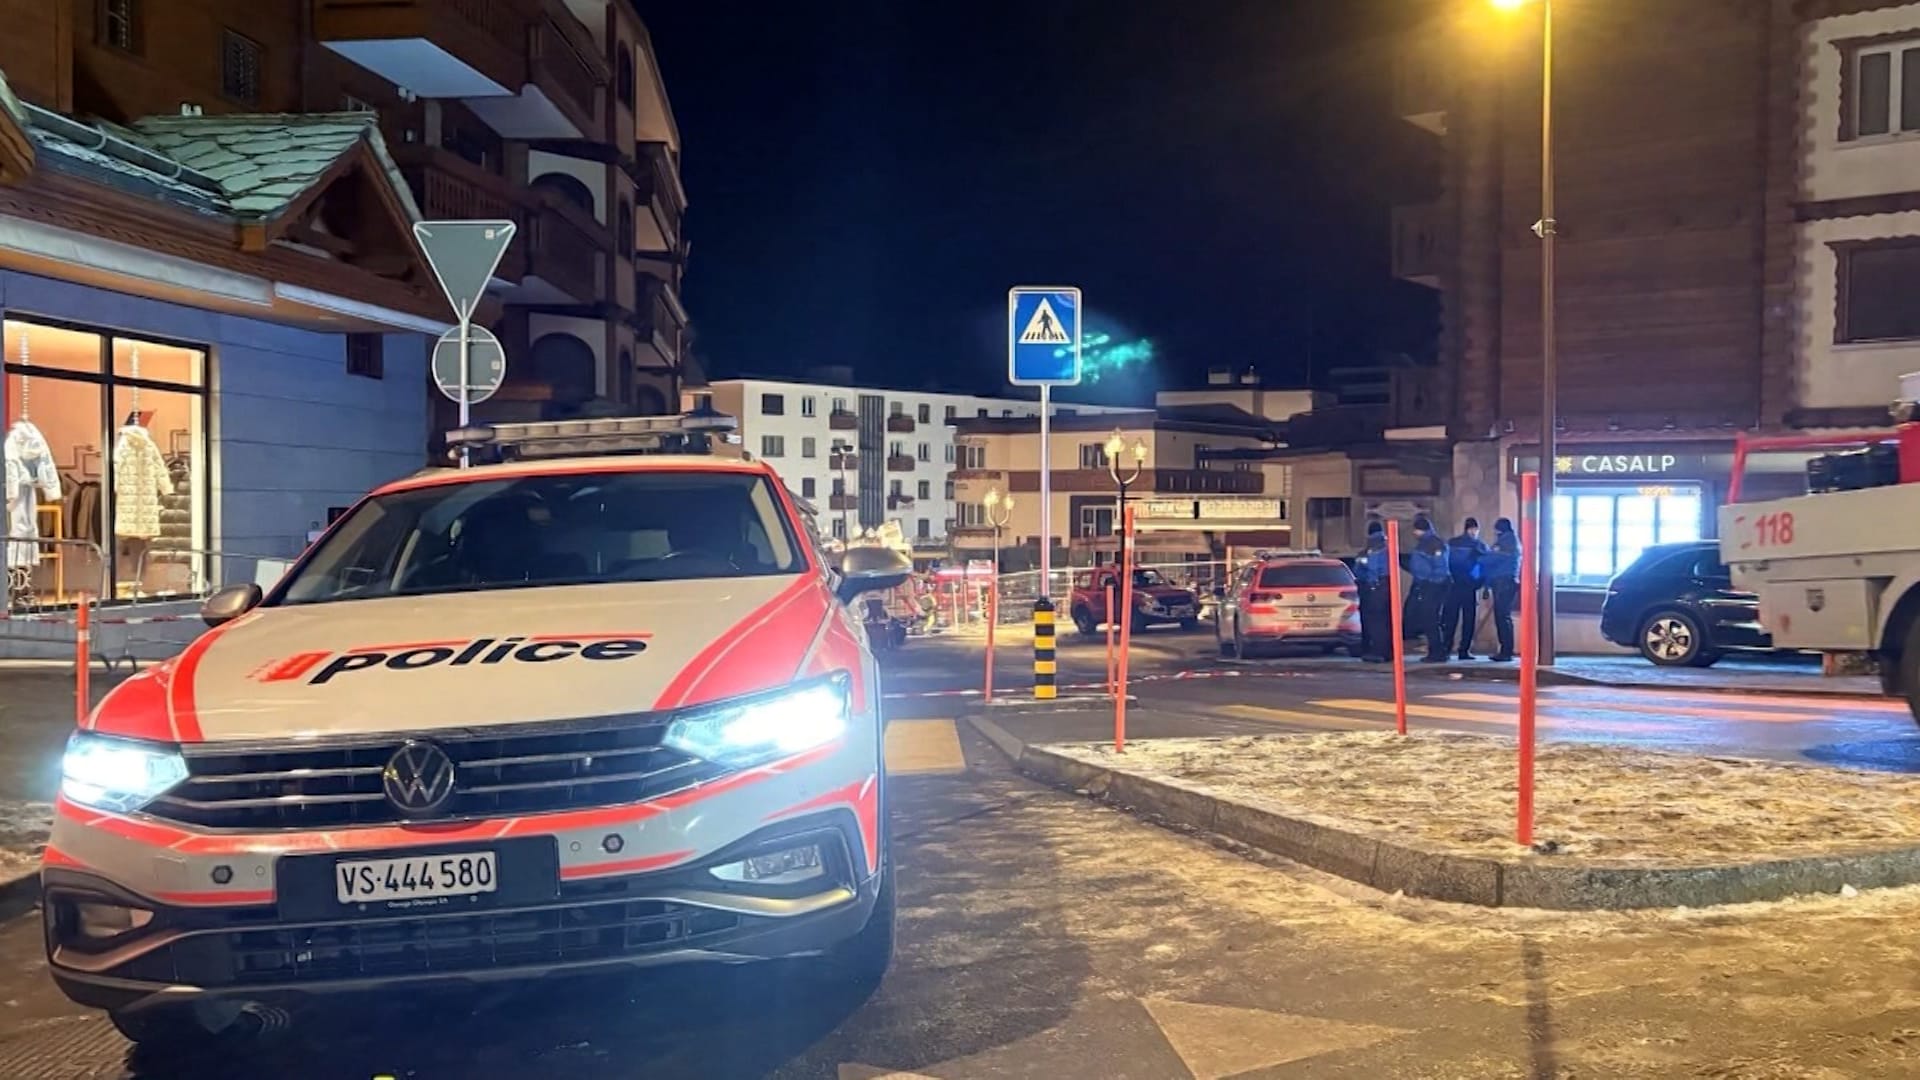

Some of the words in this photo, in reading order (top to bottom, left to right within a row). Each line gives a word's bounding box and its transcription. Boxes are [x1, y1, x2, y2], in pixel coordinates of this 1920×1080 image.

[1582, 455, 1675, 473] CASALP
[1755, 511, 1794, 546] 118
[307, 637, 648, 686] police
